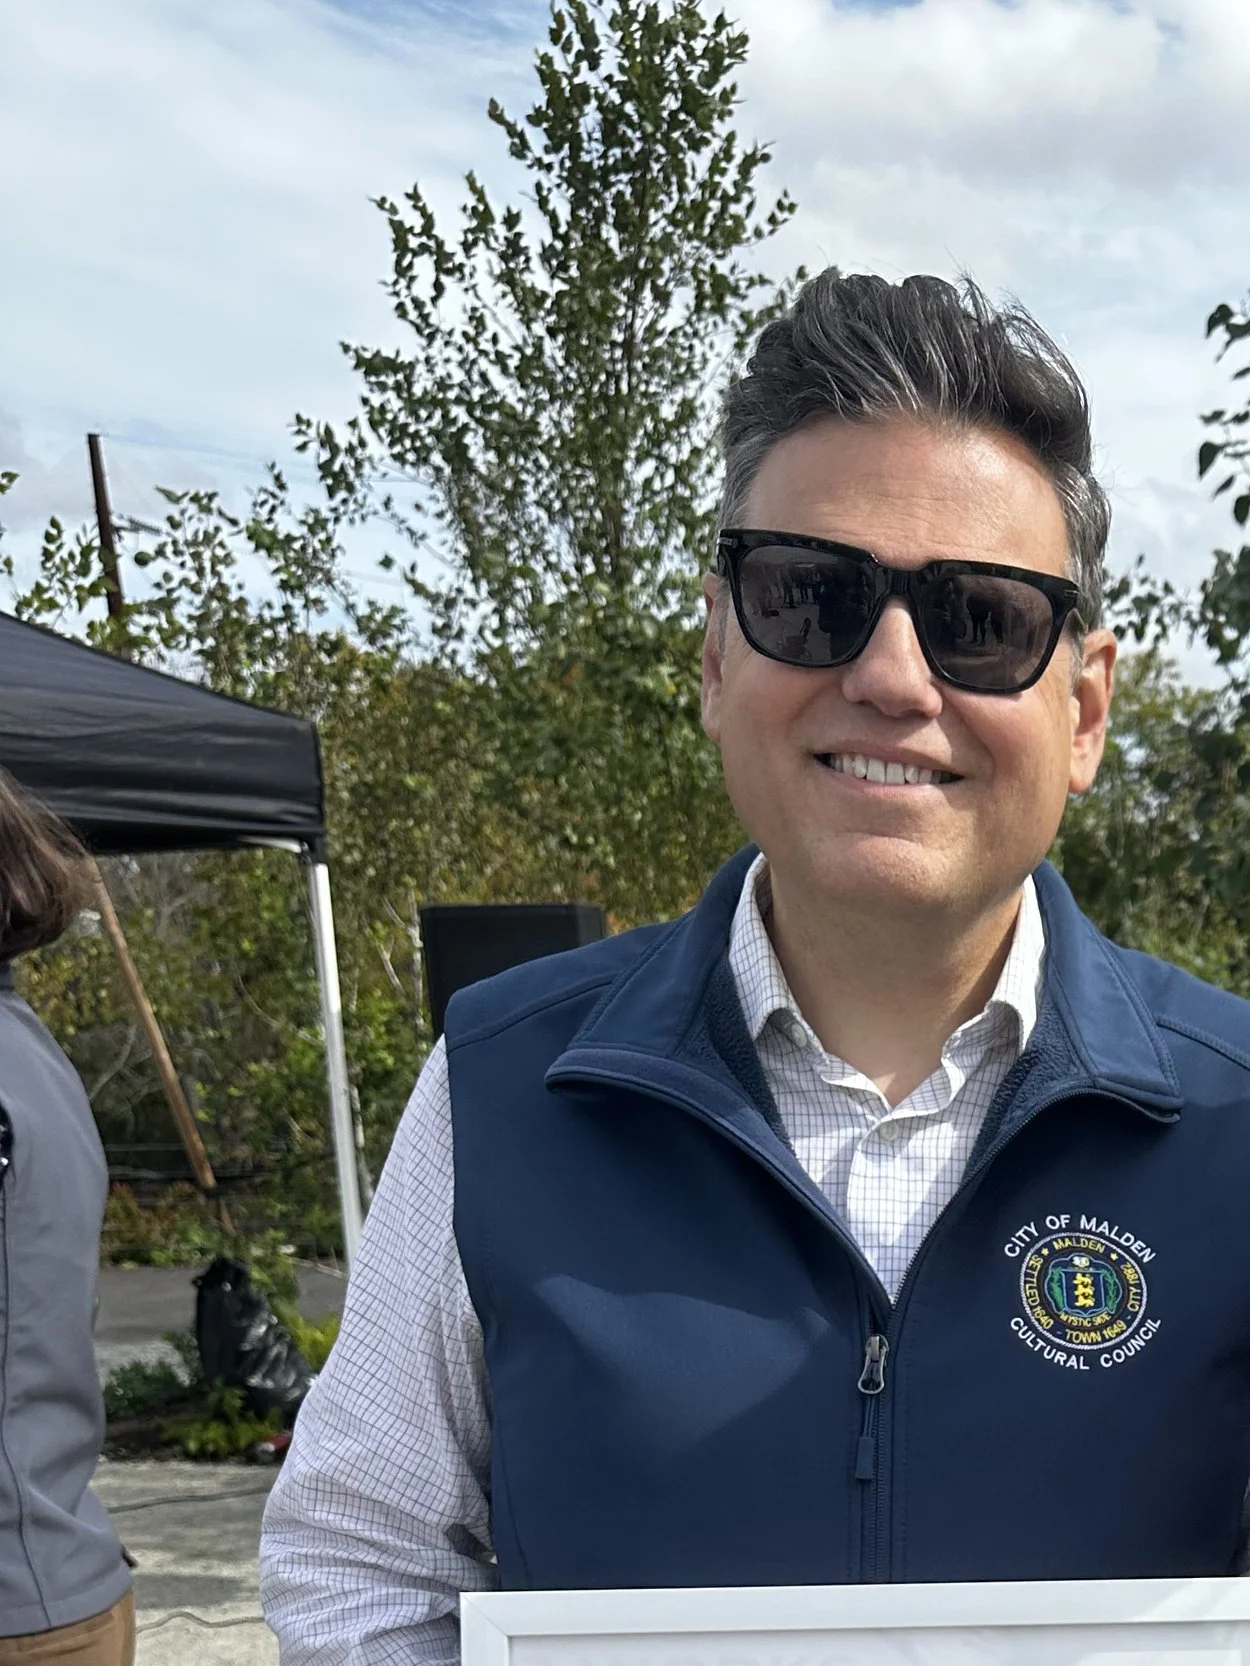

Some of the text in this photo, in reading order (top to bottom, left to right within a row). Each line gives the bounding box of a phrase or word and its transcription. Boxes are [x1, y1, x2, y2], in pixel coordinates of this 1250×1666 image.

[1004, 1214, 1157, 1263] CITY OF MALDEN
[1052, 1238, 1105, 1254] MALDEN
[1025, 1254, 1044, 1307] SETTLED
[1127, 1286, 1141, 1312] CITY
[1033, 1306, 1054, 1330] 1640
[1059, 1311, 1112, 1327] MYSTIC SIDE
[1103, 1320, 1127, 1339] 1649
[1010, 1317, 1161, 1370] CULTURAL COUNCIL
[1065, 1329, 1102, 1344] TOWN
